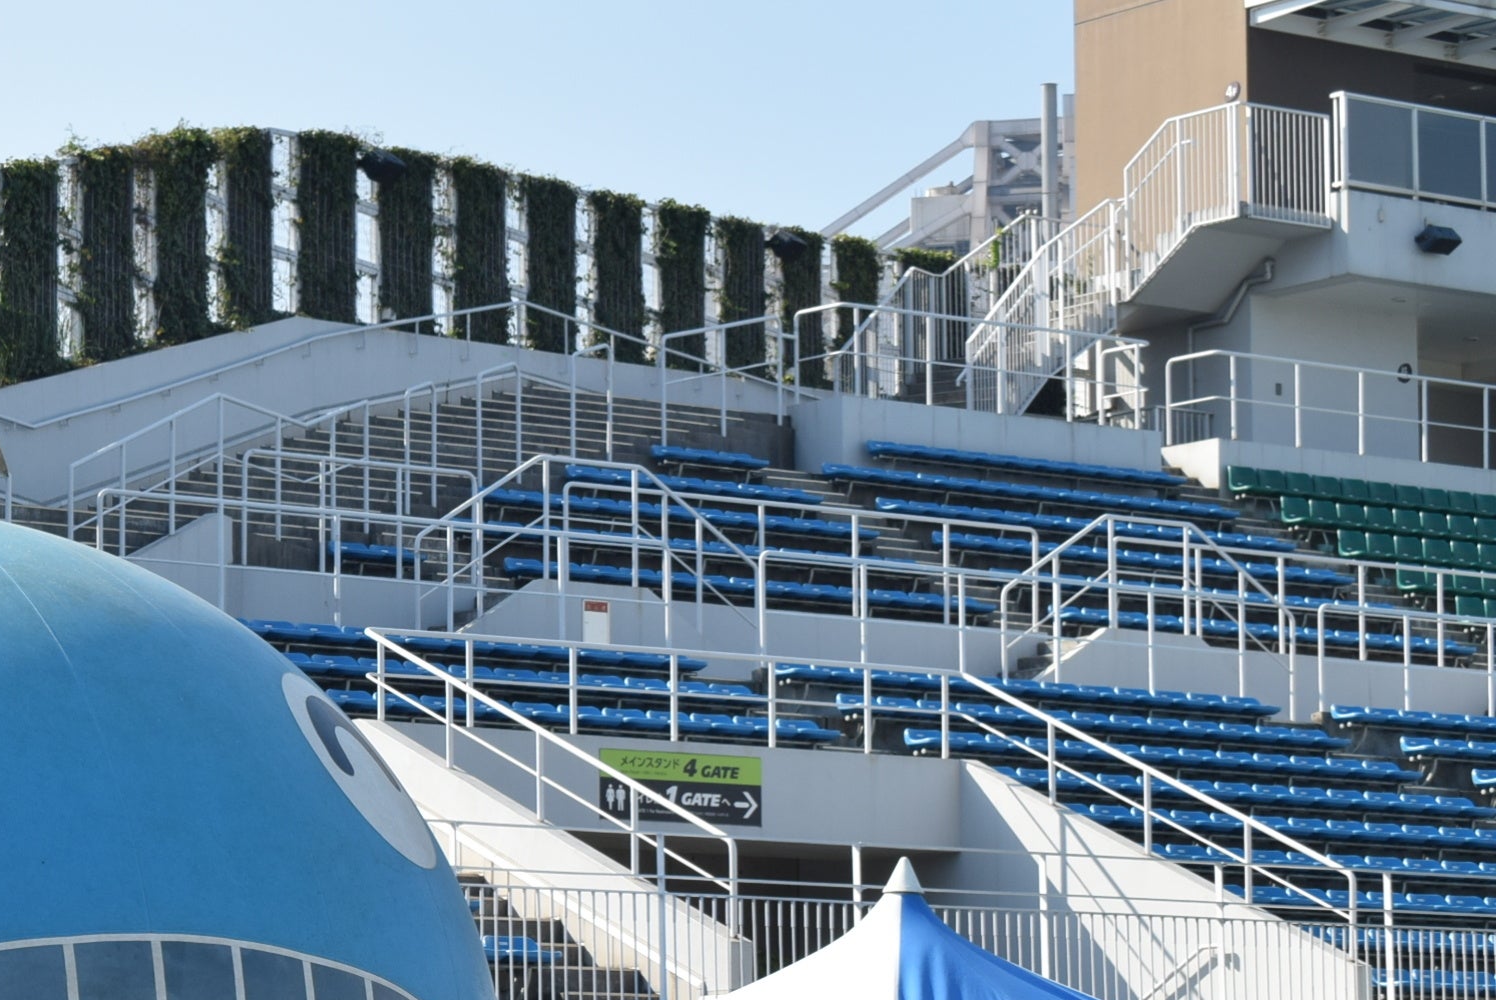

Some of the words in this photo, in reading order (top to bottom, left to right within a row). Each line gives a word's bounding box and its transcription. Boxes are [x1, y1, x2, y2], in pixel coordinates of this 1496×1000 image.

[620, 755, 680, 770] メインスタンド
[683, 758, 698, 777] 4
[701, 765, 740, 780] GATE
[665, 785, 678, 804] 1
